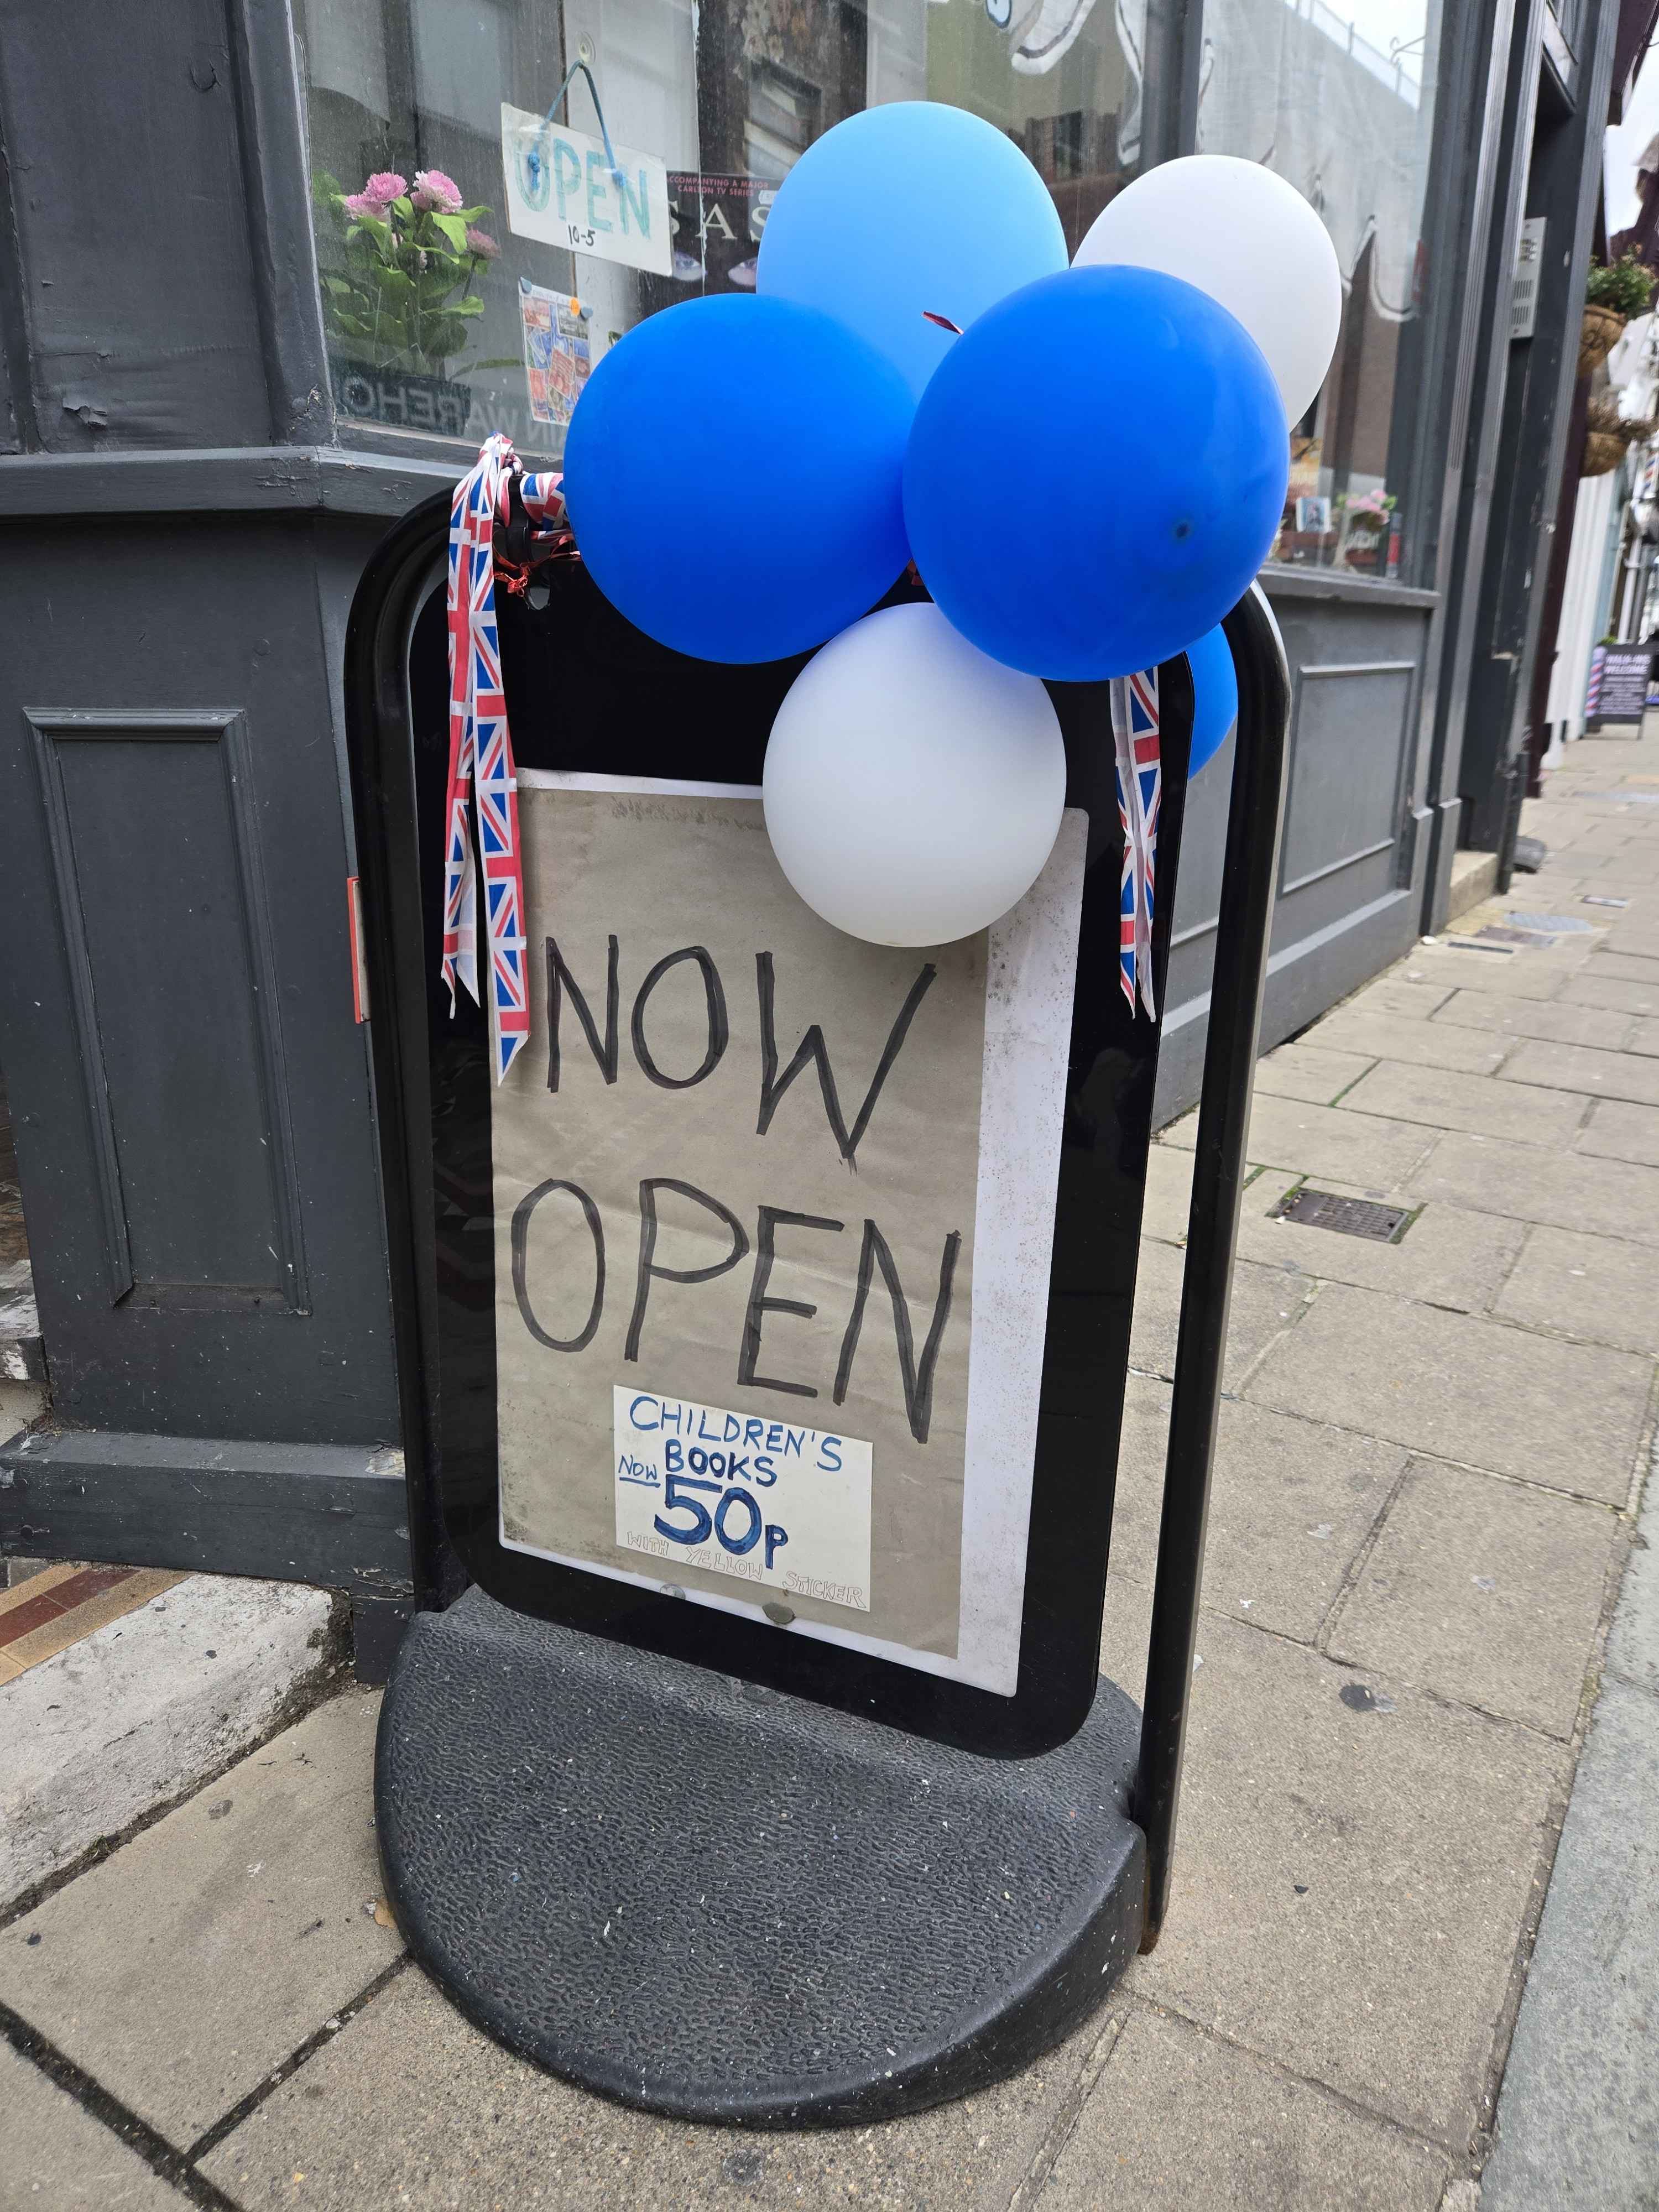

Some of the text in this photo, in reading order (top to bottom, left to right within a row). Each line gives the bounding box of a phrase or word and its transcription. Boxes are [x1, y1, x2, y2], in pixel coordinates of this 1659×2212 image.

[513, 138, 651, 240] OPEN
[729, 188, 754, 196] SERIES
[740, 180, 769, 189] MAJOR
[568, 225, 596, 247] 10-5
[545, 934, 937, 1161] NOW
[512, 1178, 962, 1444] OPEN
[629, 1396, 842, 1472] CHILDREN'S
[665, 1438, 778, 1487] BOOKS
[627, 1531, 867, 1609] WITH YELLOW STICKER
